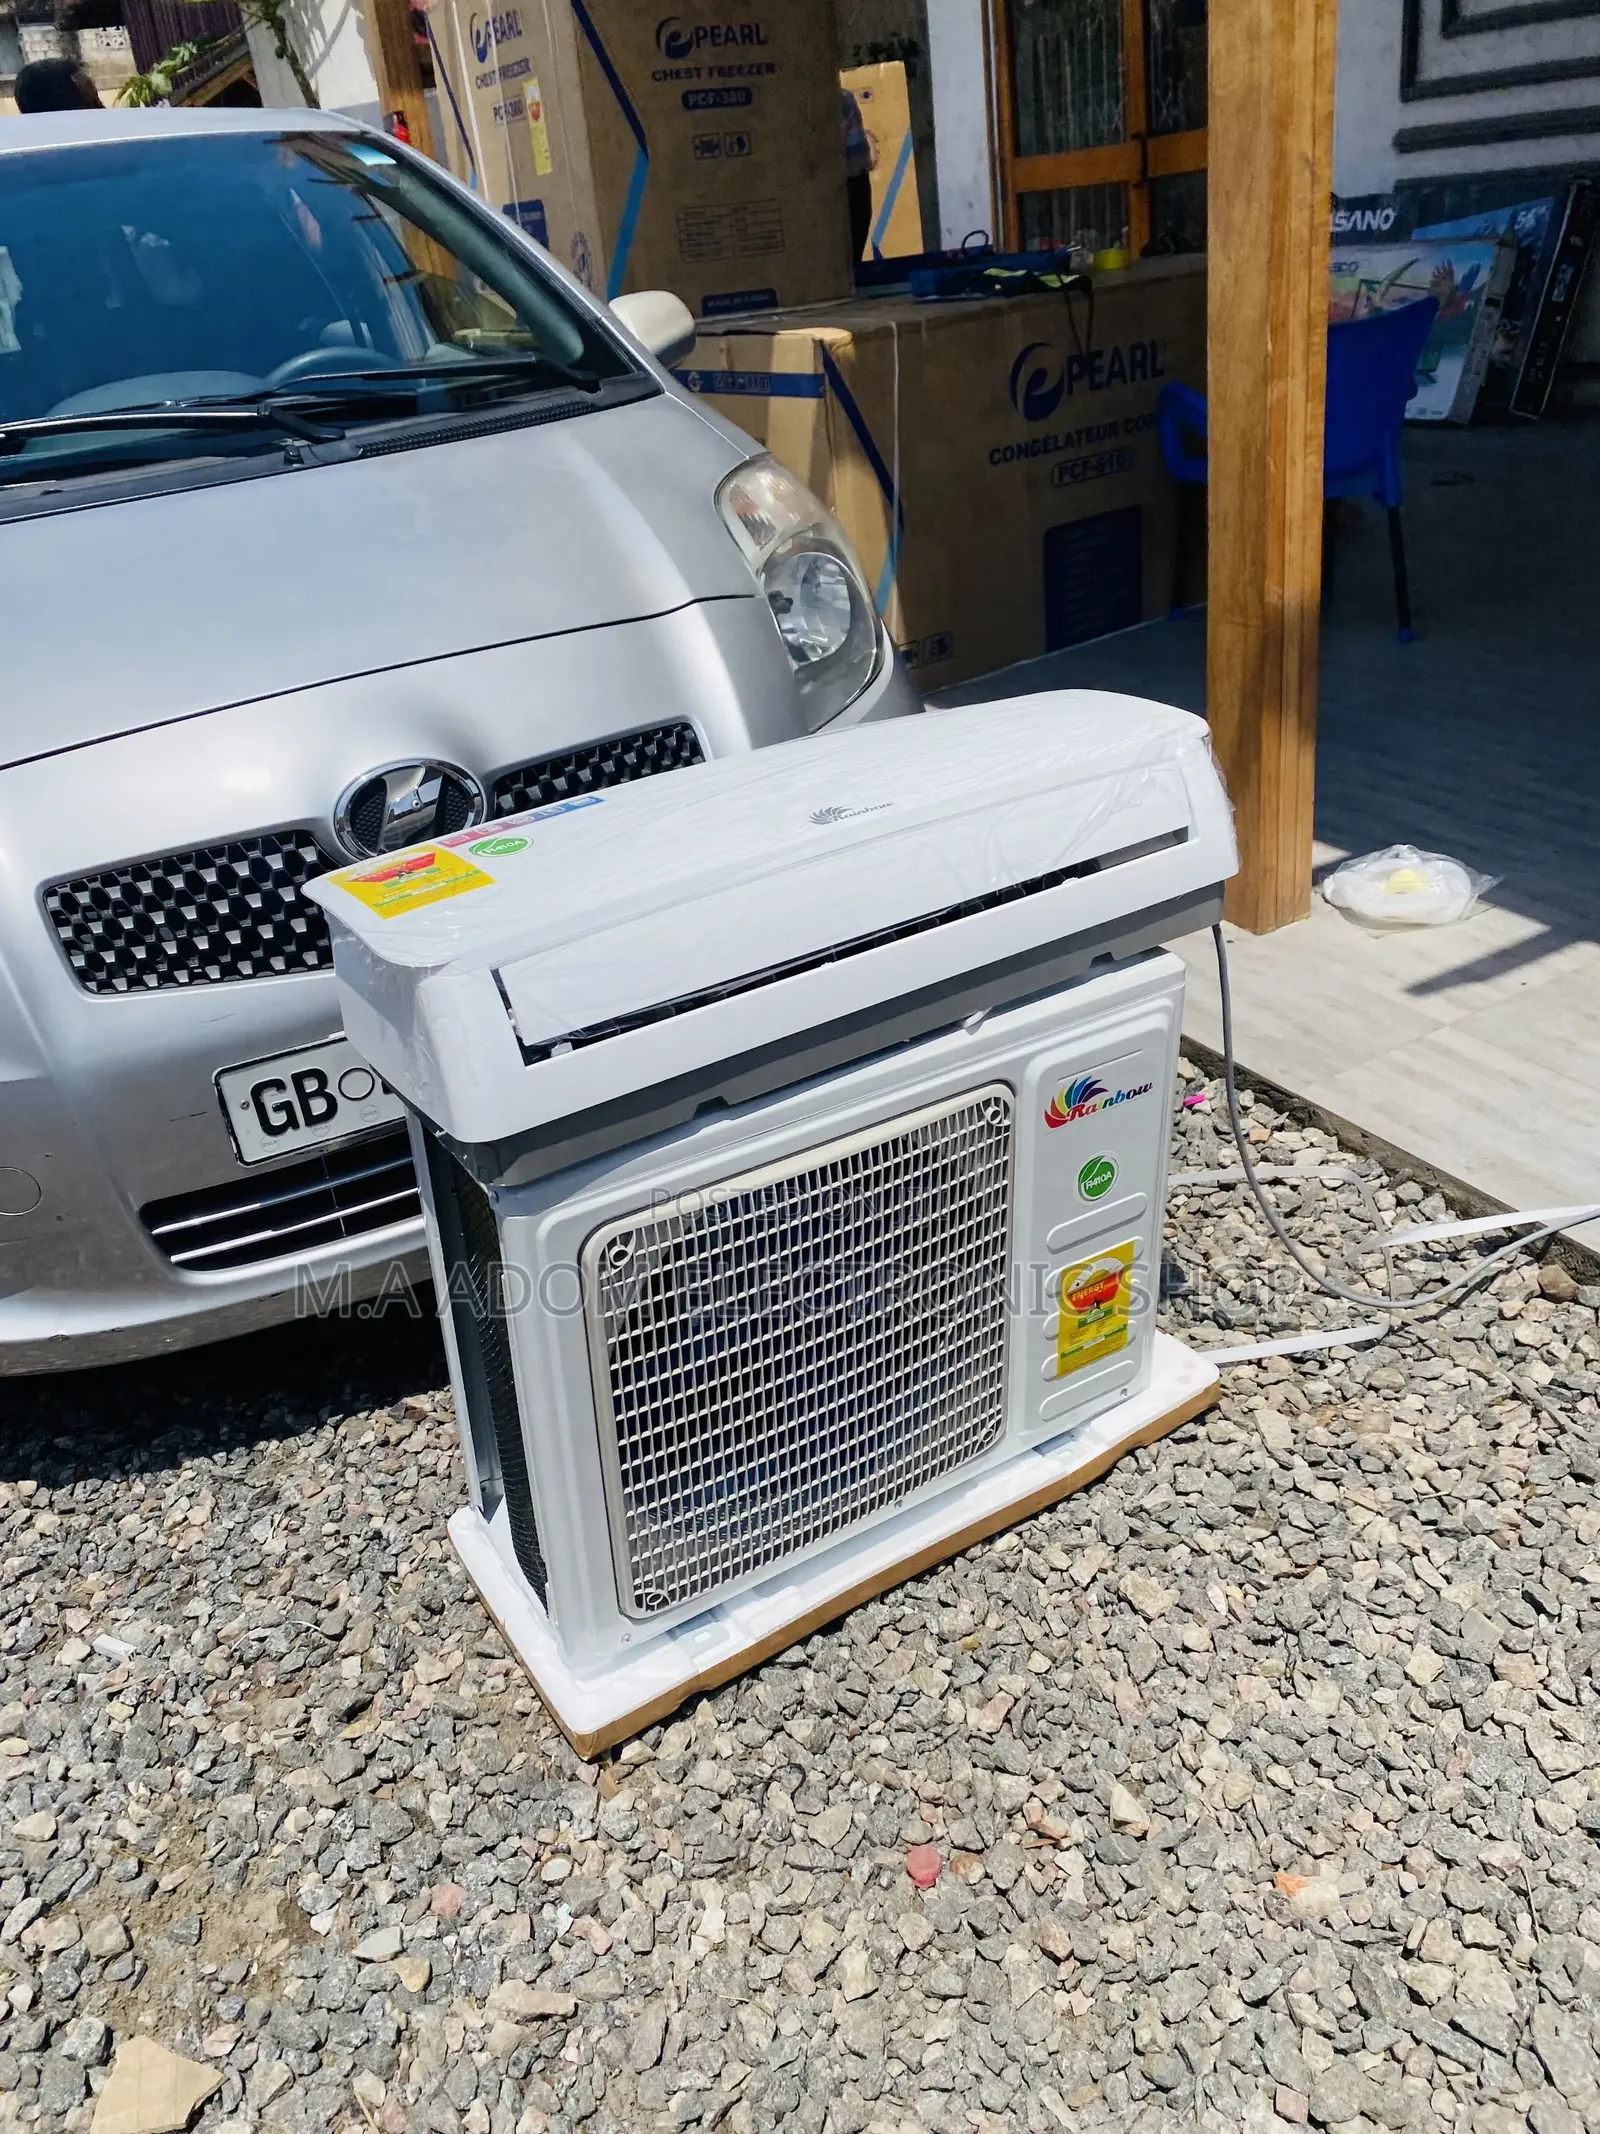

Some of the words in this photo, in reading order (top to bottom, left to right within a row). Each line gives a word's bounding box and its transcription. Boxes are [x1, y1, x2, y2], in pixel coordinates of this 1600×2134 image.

[694, 23, 768, 49] PEARL
[651, 66, 702, 81] CHEST
[708, 62, 776, 78] FREEZER
[1331, 207, 1396, 232] SANO
[1066, 339, 1165, 396] PEARL
[250, 1066, 339, 1137] GB
[1066, 1082, 1154, 1122] Rainbow
[1085, 1171, 1113, 1190] R410A
[1072, 1282, 1105, 1301] ENERGY
